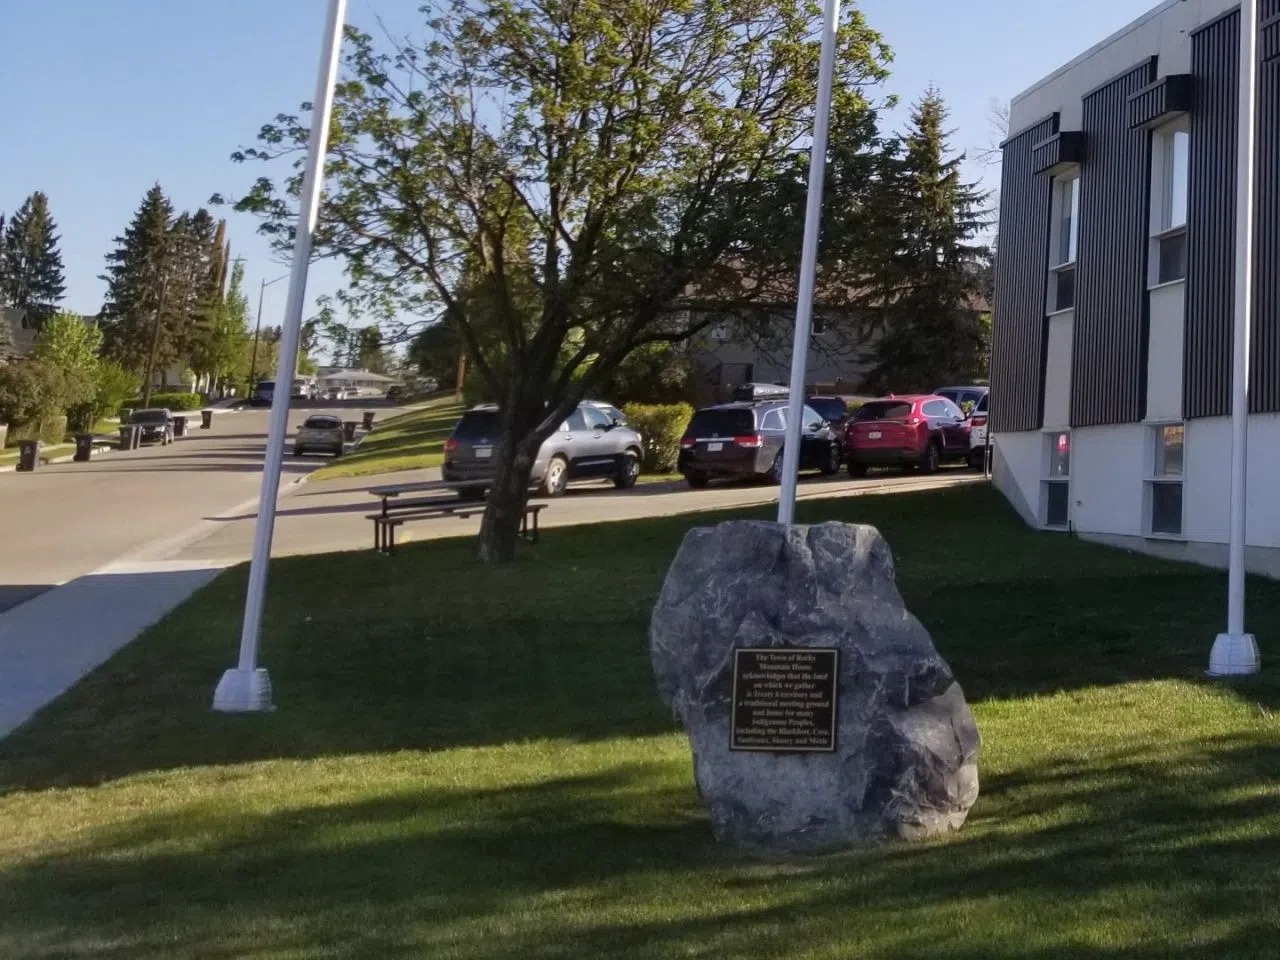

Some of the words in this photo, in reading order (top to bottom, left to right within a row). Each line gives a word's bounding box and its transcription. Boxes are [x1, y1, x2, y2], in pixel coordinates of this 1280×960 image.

[788, 653, 795, 661] of
[796, 653, 816, 664] Rocky
[760, 663, 790, 671] Mountain
[792, 663, 812, 671] House
[742, 672, 785, 681] acknowledges
[787, 672, 800, 680] that
[801, 672, 811, 680] the
[813, 672, 828, 680] land
[764, 681, 783, 689] which
[794, 681, 815, 690] gather
[754, 690, 774, 699] Treaty
[780, 691, 808, 700] territory
[744, 699, 778, 707] traditional
[779, 700, 805, 709] meeting
[806, 700, 830, 709] ground
[796, 711, 814, 719] many
[752, 718, 787, 727] Indigenous
[767, 727, 777, 735] the
[795, 736, 808, 744] and
